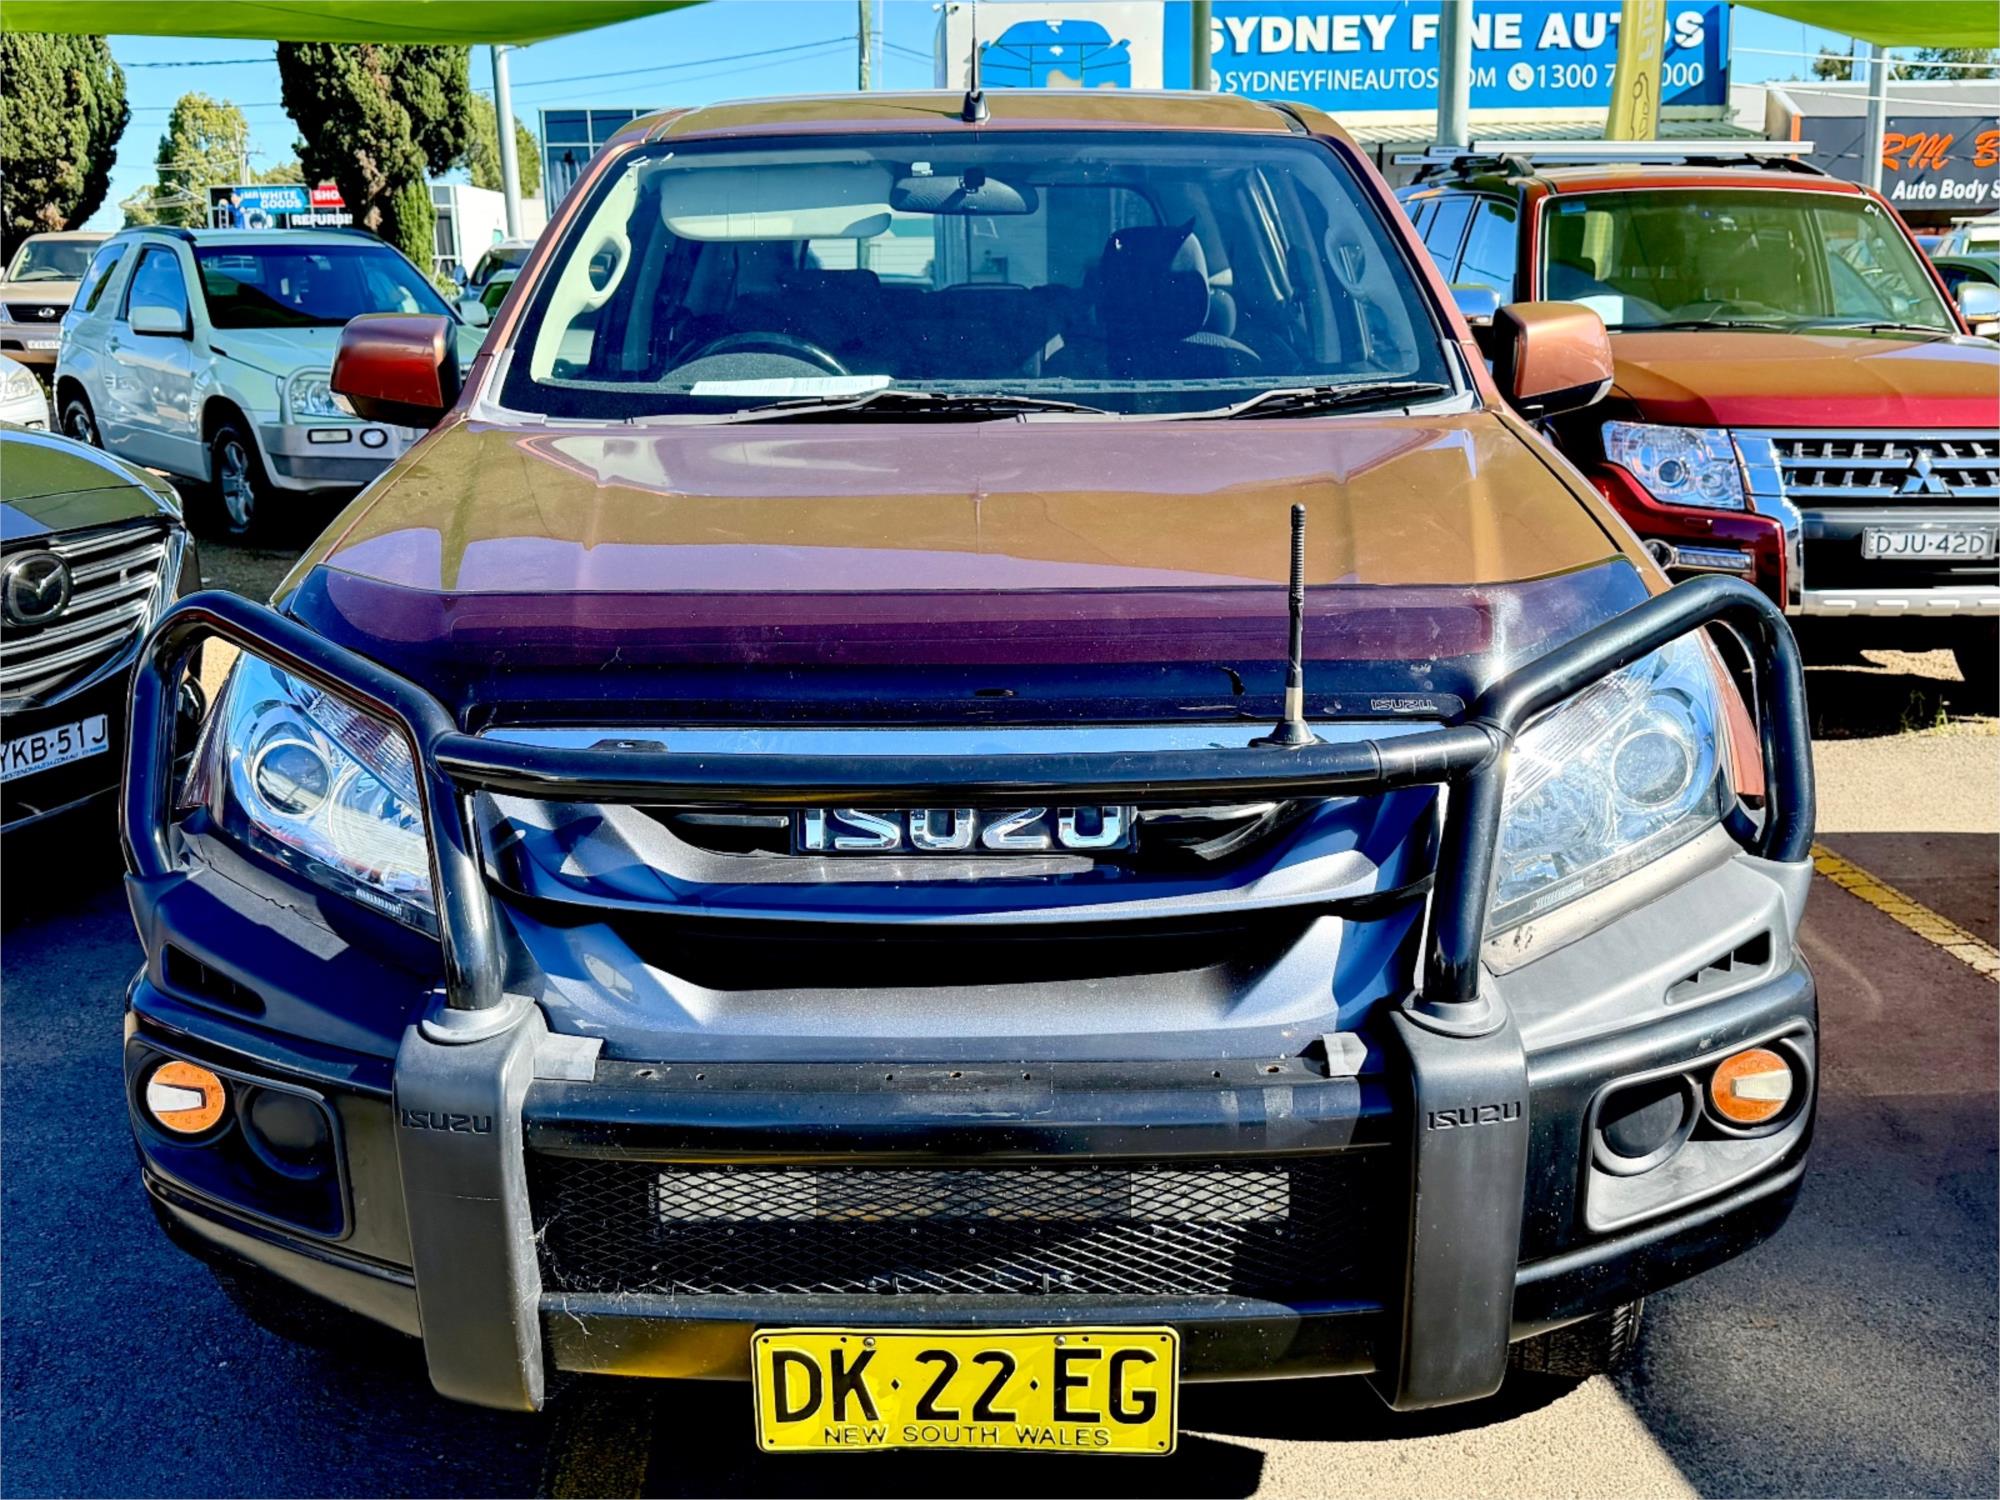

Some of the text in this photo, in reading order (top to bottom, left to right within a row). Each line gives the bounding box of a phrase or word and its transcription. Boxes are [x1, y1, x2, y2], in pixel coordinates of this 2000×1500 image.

[1411, 13, 1522, 50] FNE
[1538, 10, 1705, 50] AUS
[1225, 65, 1496, 93] SYDNEYFINEAUTOSM
[1537, 63, 1598, 89] 1300
[1883, 132, 1953, 170] RM
[259, 190, 297, 201] WHITE
[260, 199, 303, 209] GOODS
[1891, 179, 1937, 200] Auto
[1939, 178, 1989, 204] Body
[1371, 698, 1438, 712] ISUZU
[805, 807, 1122, 850] ISUZU
[401, 1108, 492, 1135] ISUZU
[1427, 1101, 1521, 1131] ISUZU
[823, 1423, 1111, 1447] NEW SOUTH WALES
